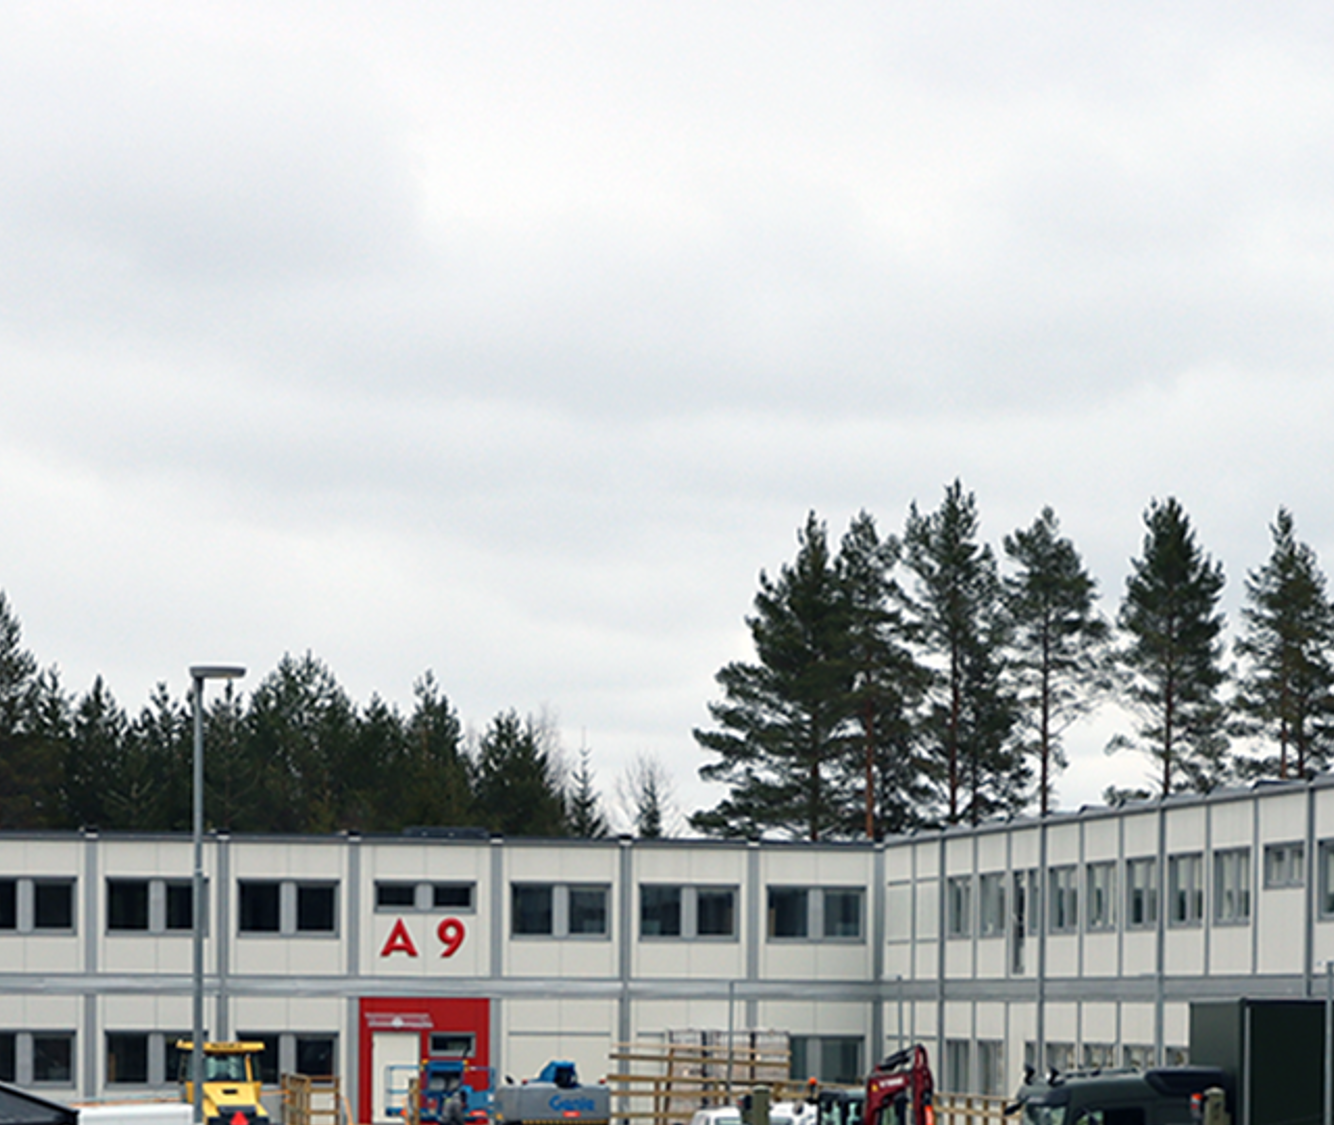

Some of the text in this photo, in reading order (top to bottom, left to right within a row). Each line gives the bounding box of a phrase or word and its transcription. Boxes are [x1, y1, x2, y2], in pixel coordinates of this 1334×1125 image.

[380, 916, 466, 958] A 9
[549, 1095, 595, 1111] Genie
